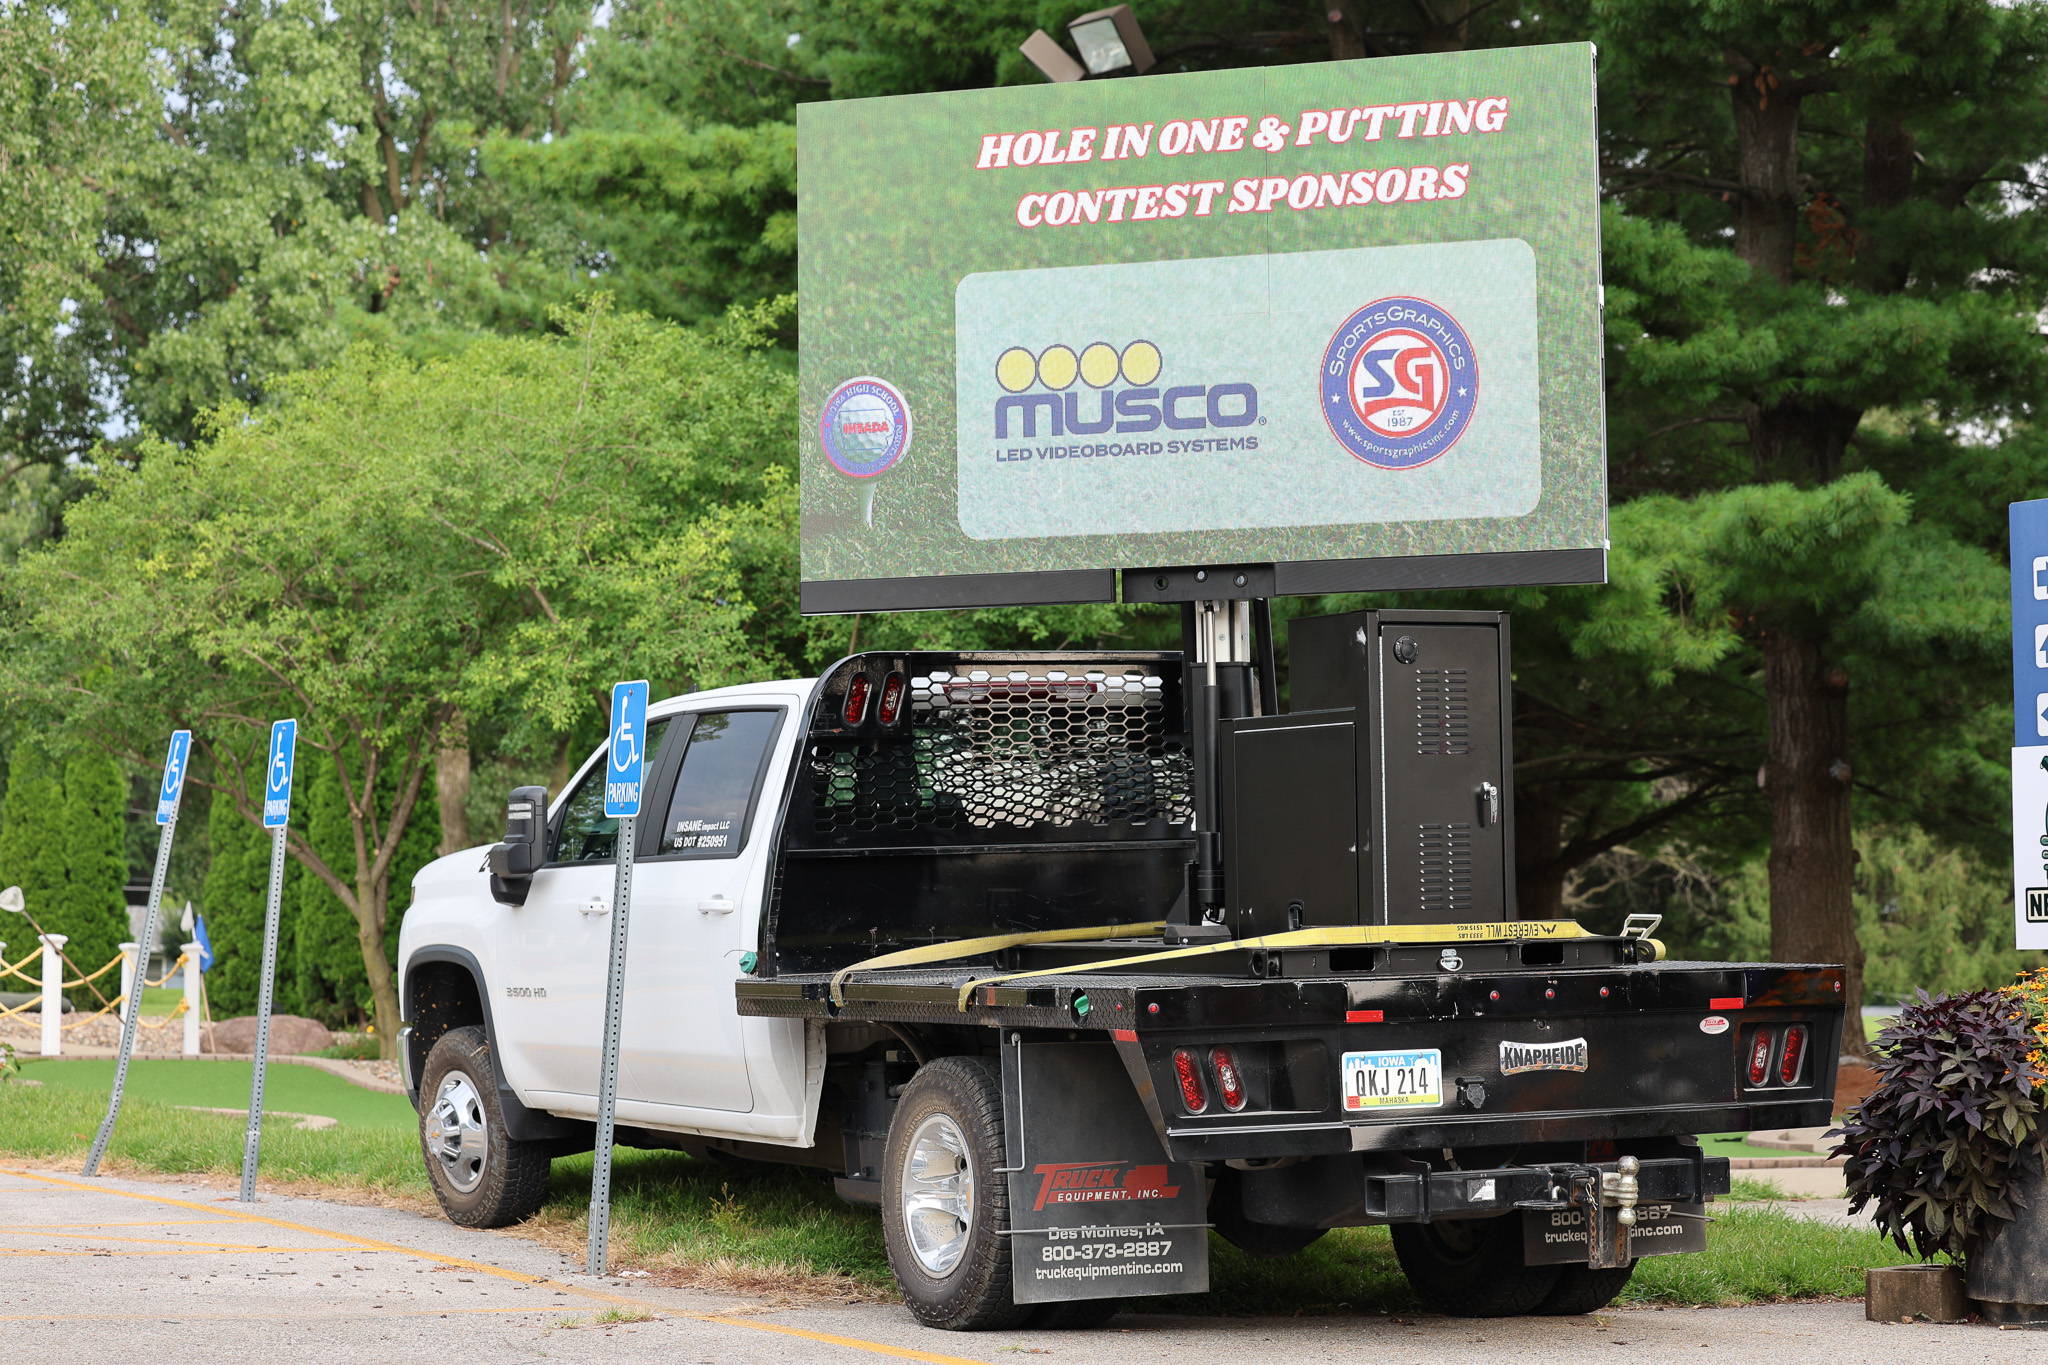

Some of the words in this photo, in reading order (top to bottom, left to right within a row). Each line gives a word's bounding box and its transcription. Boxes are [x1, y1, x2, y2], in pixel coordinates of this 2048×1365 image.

[975, 127, 1097, 169] HOLE
[1100, 123, 1155, 160] IN
[1158, 115, 1249, 156] ONE
[1251, 114, 1290, 153] &
[1294, 95, 1509, 147] PUTTING
[1016, 180, 1225, 228] CONTEST
[1226, 163, 1471, 213] SPONSORS
[1363, 347, 1434, 411] SG
[846, 384, 870, 398] HIGH
[871, 385, 900, 416] SCHOOL
[843, 421, 889, 434] IHSADA
[1387, 417, 1413, 427] 1987
[1342, 409, 1460, 459] www.sportsgraphicsinc.com
[996, 447, 1032, 462] LED
[1036, 441, 1163, 460] VIDEOBOARD
[1167, 436, 1259, 453] SYSTEMS
[607, 781, 639, 803] PARKING
[265, 798, 288, 816] PARKING
[677, 820, 703, 832] INSANE
[702, 821, 719, 832] impact
[720, 821, 731, 830] LLC
[674, 837, 684, 848] US
[683, 836, 697, 847] DOT
[1503, 923, 1539, 938] EVEREST
[506, 987, 531, 997] 3500
[533, 987, 547, 997] HD
[1378, 1056, 1406, 1067] IOWA
[1503, 1043, 1584, 1070] KNAPHEIDE
[1356, 1068, 1389, 1096] QKJ
[1397, 1067, 1428, 1095] 214
[1379, 1096, 1409, 1105] MAHASKA
[1033, 1161, 1128, 1211] TRUCK
[1057, 1190, 1131, 1202] EQUIPMENT,
[1137, 1188, 1163, 1198] INC.
[1048, 1226, 1077, 1240] Des
[1146, 1222, 1165, 1236] IA
[1042, 1241, 1172, 1261] 800-373-2887
[1035, 1261, 1183, 1280] truckequipmentinc.com
